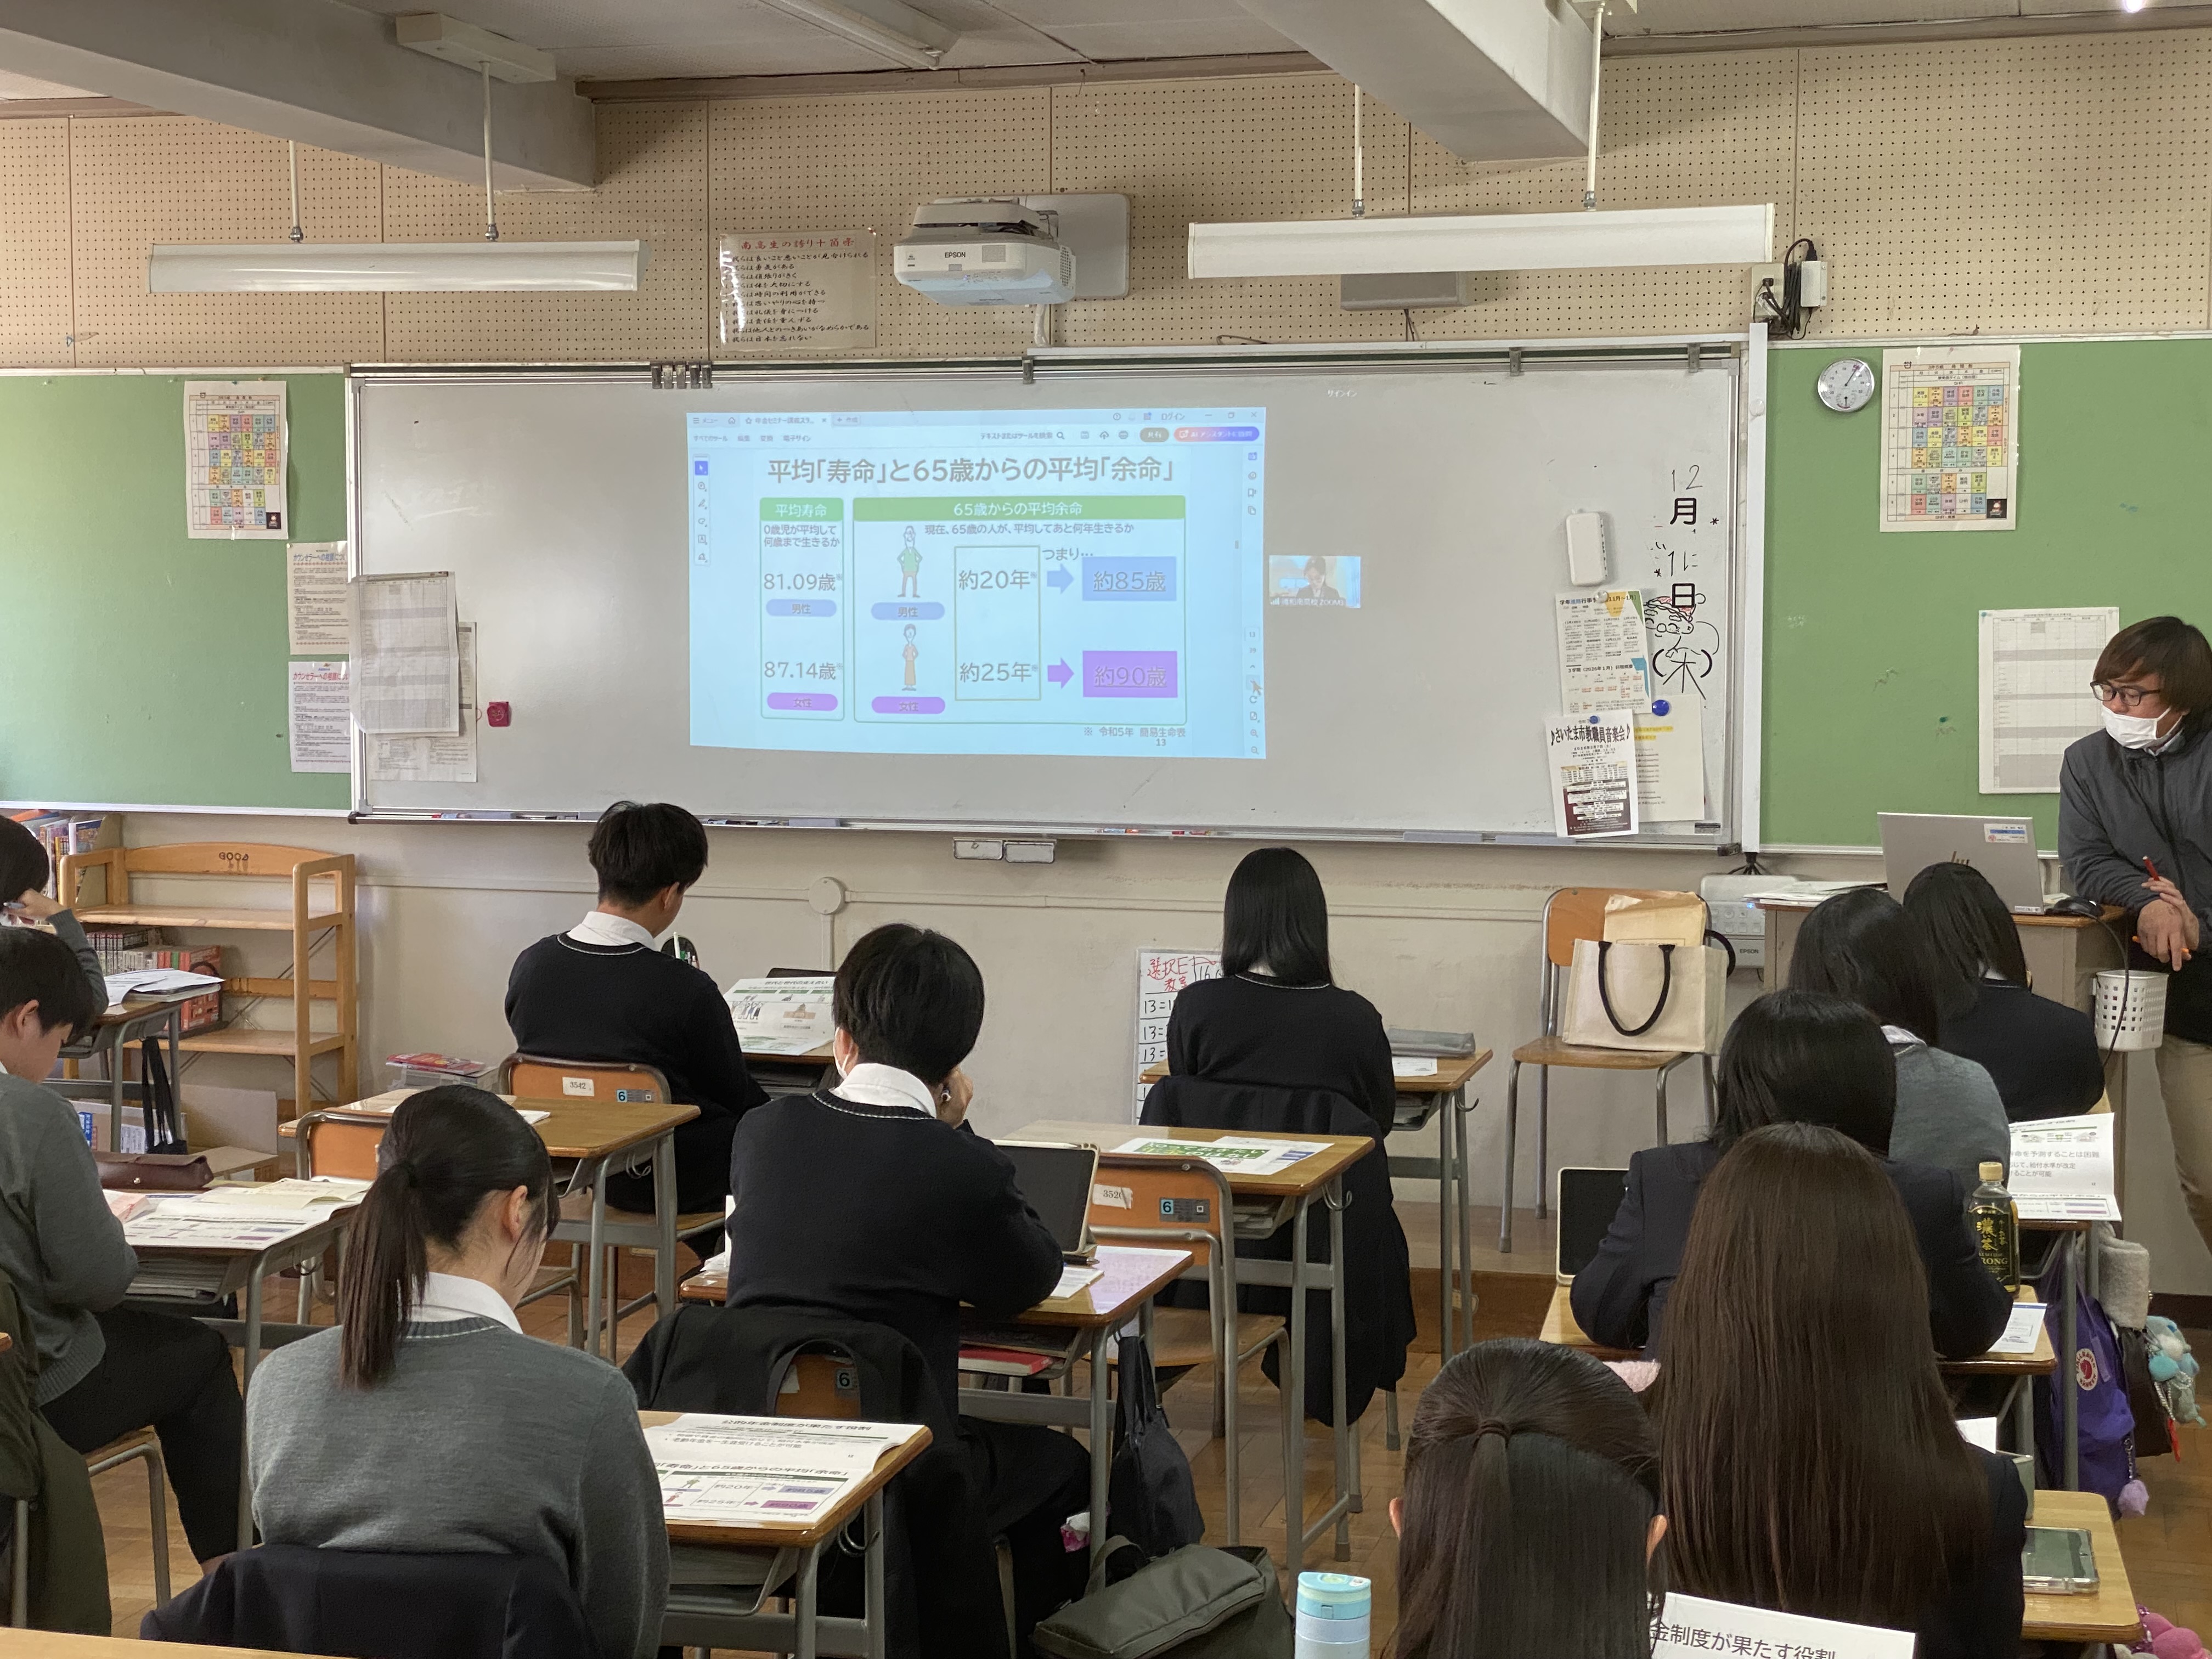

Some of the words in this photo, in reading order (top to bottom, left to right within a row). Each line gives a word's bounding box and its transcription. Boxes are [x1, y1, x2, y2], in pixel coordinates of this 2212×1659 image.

[1327, 389, 1357, 398] サインイン
[1161, 412, 1185, 421] ログイン
[768, 456, 1173, 484] 平均「寿命」と65歳からの平均「余命」
[1672, 464, 1703, 492] 12
[775, 504, 827, 517] 平均寿命
[953, 502, 1083, 516] 65歳からの平均余命
[1670, 498, 1697, 526] 月
[763, 524, 837, 535] 0歳児が平均して
[924, 523, 1135, 535] 現在、65歳の人が、平均してあと何年生きるか
[763, 537, 840, 548] 何歳まで生きるか
[1093, 571, 1166, 592] 約85歳
[1672, 583, 1695, 608] 日
[792, 603, 811, 615] 男性
[898, 606, 918, 618] 男性
[1094, 666, 1167, 687] 約90歳
[793, 698, 812, 708] 女性
[899, 701, 919, 712] 女性
[1099, 727, 1134, 737] 令和5年
[1140, 727, 1186, 738] 簡易生命表
[1156, 738, 1166, 747] 13
[569, 1081, 586, 1090] 3542
[618, 1091, 626, 1102] 6
[1163, 1201, 1172, 1213] 6
[839, 1372, 850, 1387] 6
